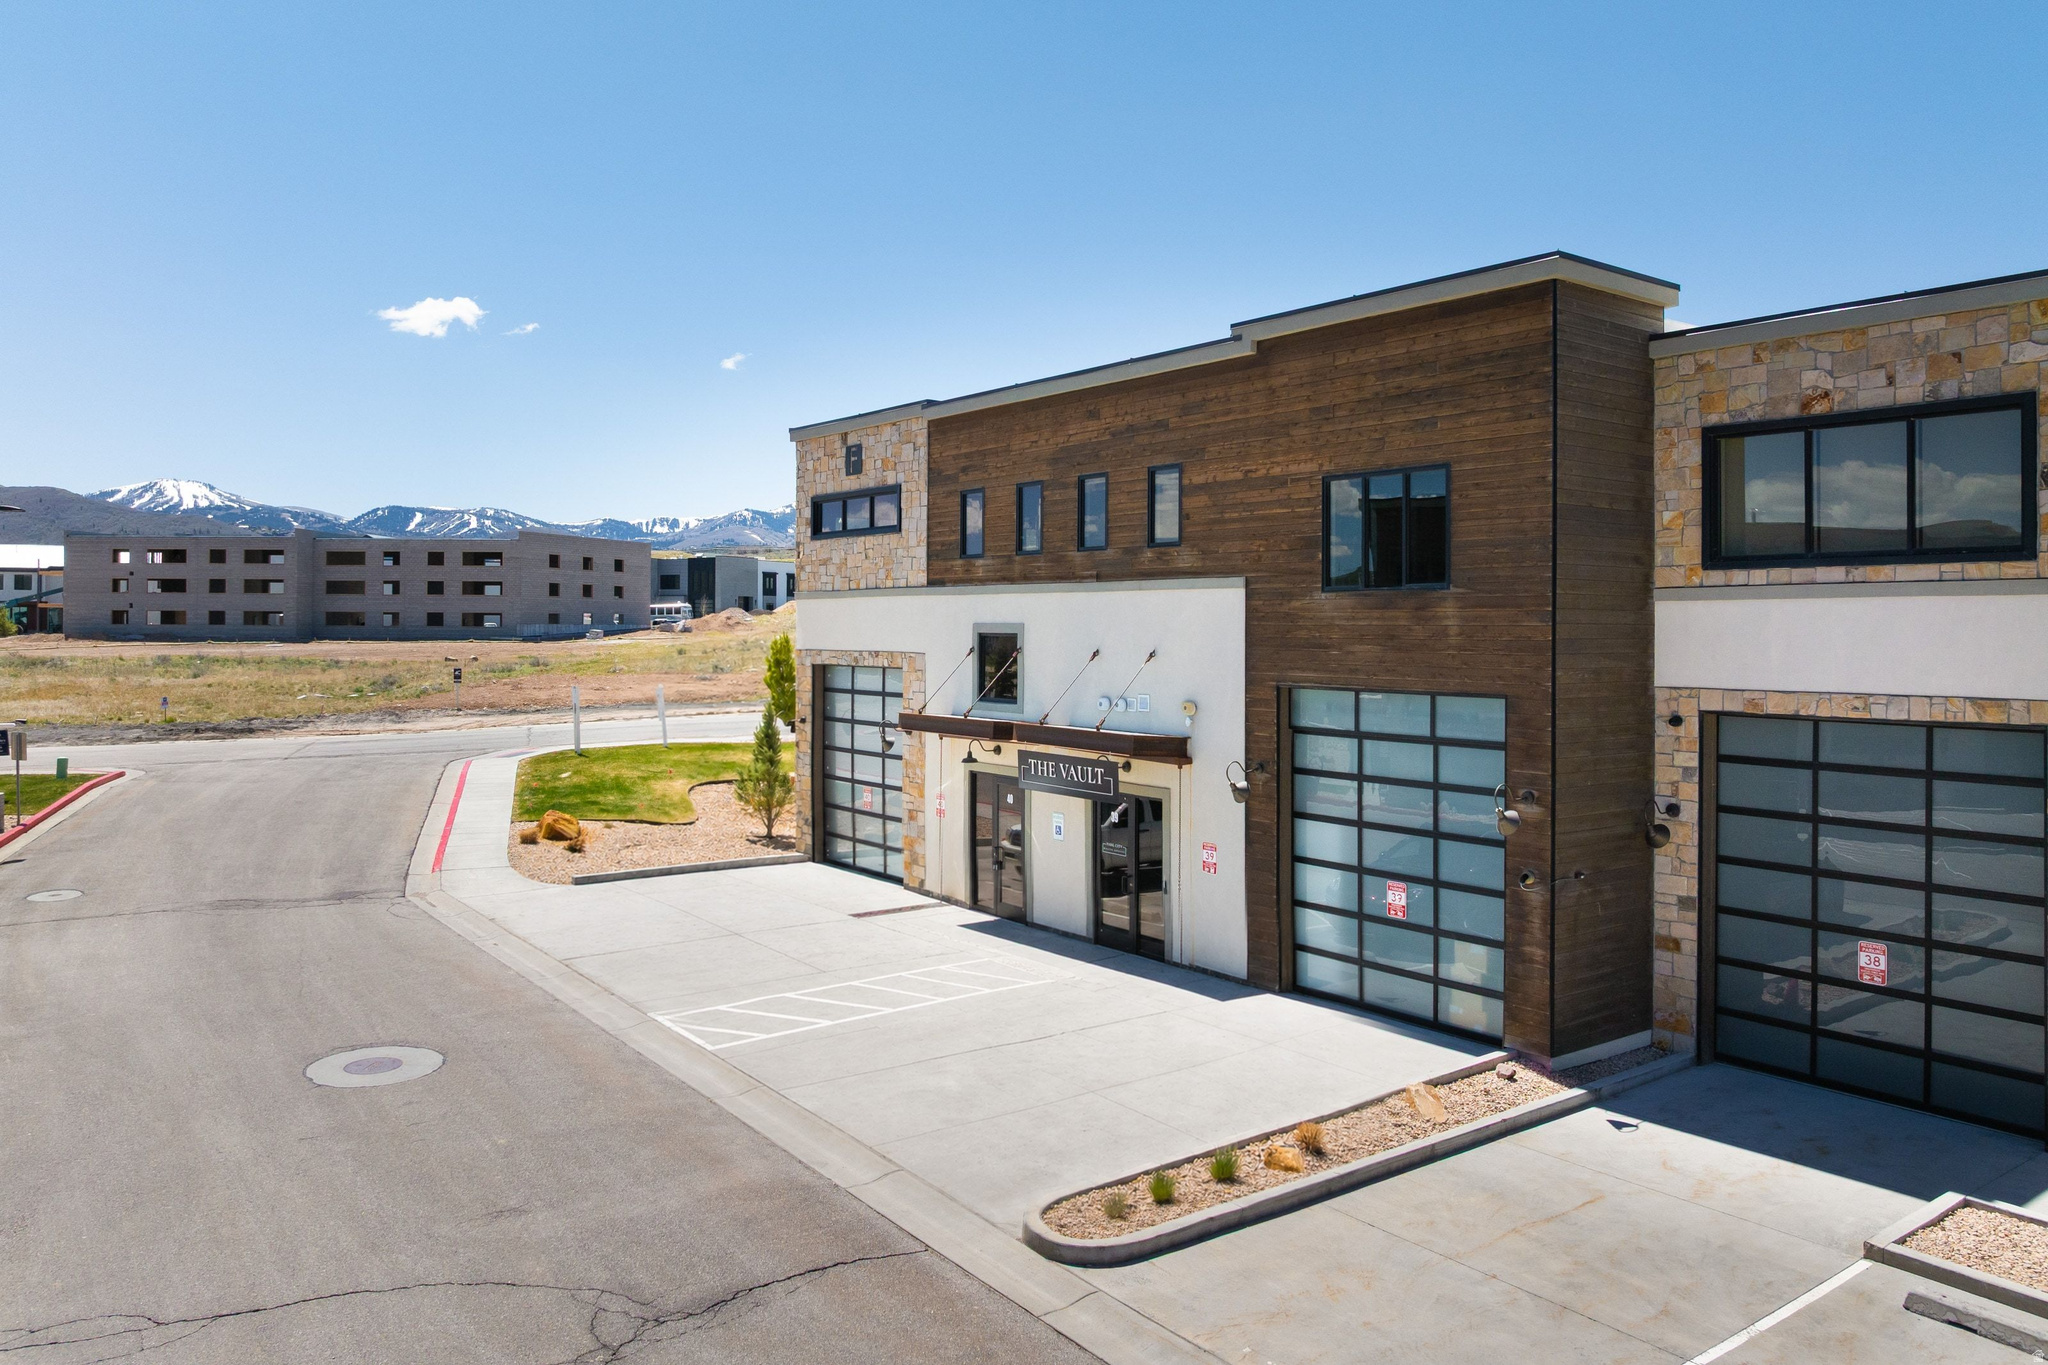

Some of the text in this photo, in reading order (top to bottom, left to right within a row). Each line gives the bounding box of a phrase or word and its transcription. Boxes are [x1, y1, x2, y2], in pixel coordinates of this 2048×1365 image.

[1028, 758, 1105, 785] THE VAULT
[1205, 852, 1214, 860] 39
[1391, 893, 1402, 902] 39
[1860, 942, 1885, 950] RESERVED
[1861, 947, 1884, 955] PARKING
[1864, 955, 1881, 967] 38
